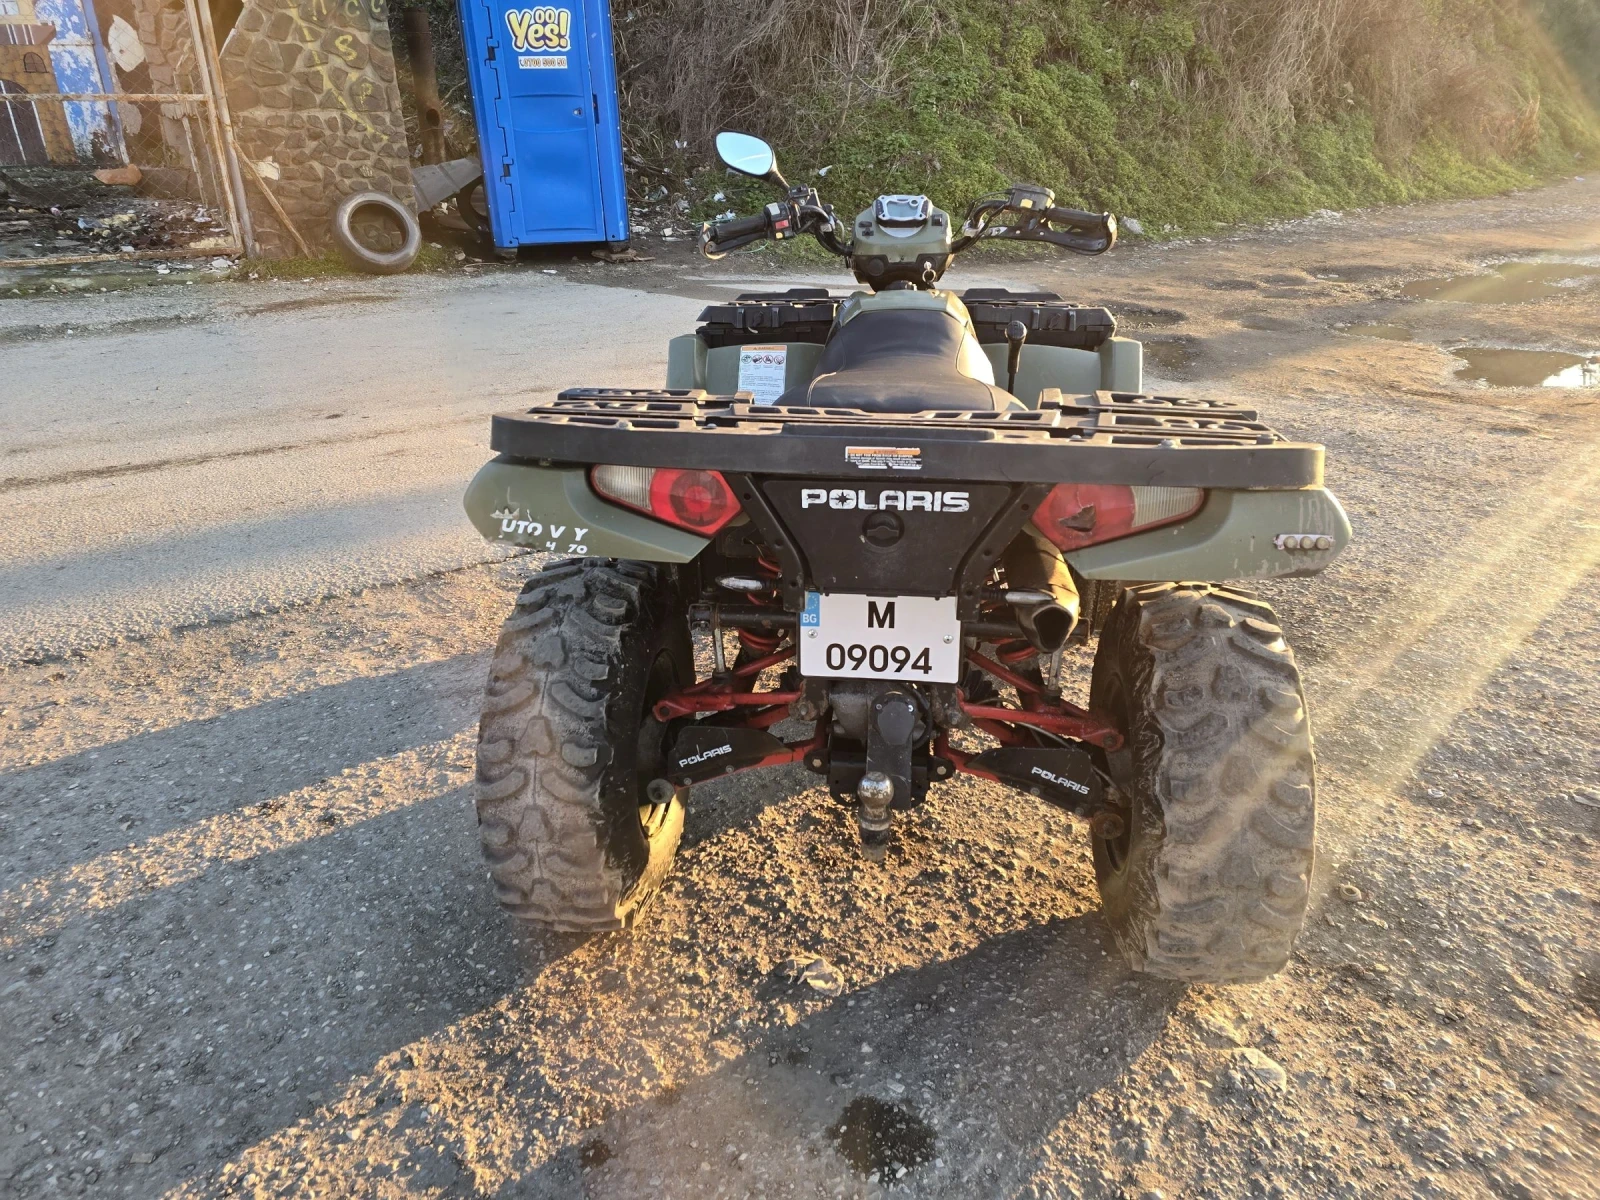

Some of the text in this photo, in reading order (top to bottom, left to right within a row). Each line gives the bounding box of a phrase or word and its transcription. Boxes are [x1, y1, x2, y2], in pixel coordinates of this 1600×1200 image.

[507, 9, 569, 50] Yes!
[801, 488, 970, 512] POLARIS
[802, 613, 817, 624] BG
[867, 600, 896, 629] M
[825, 643, 933, 675] 09094
[678, 744, 732, 768] POLARIS
[1031, 766, 1090, 795] POLARIS
